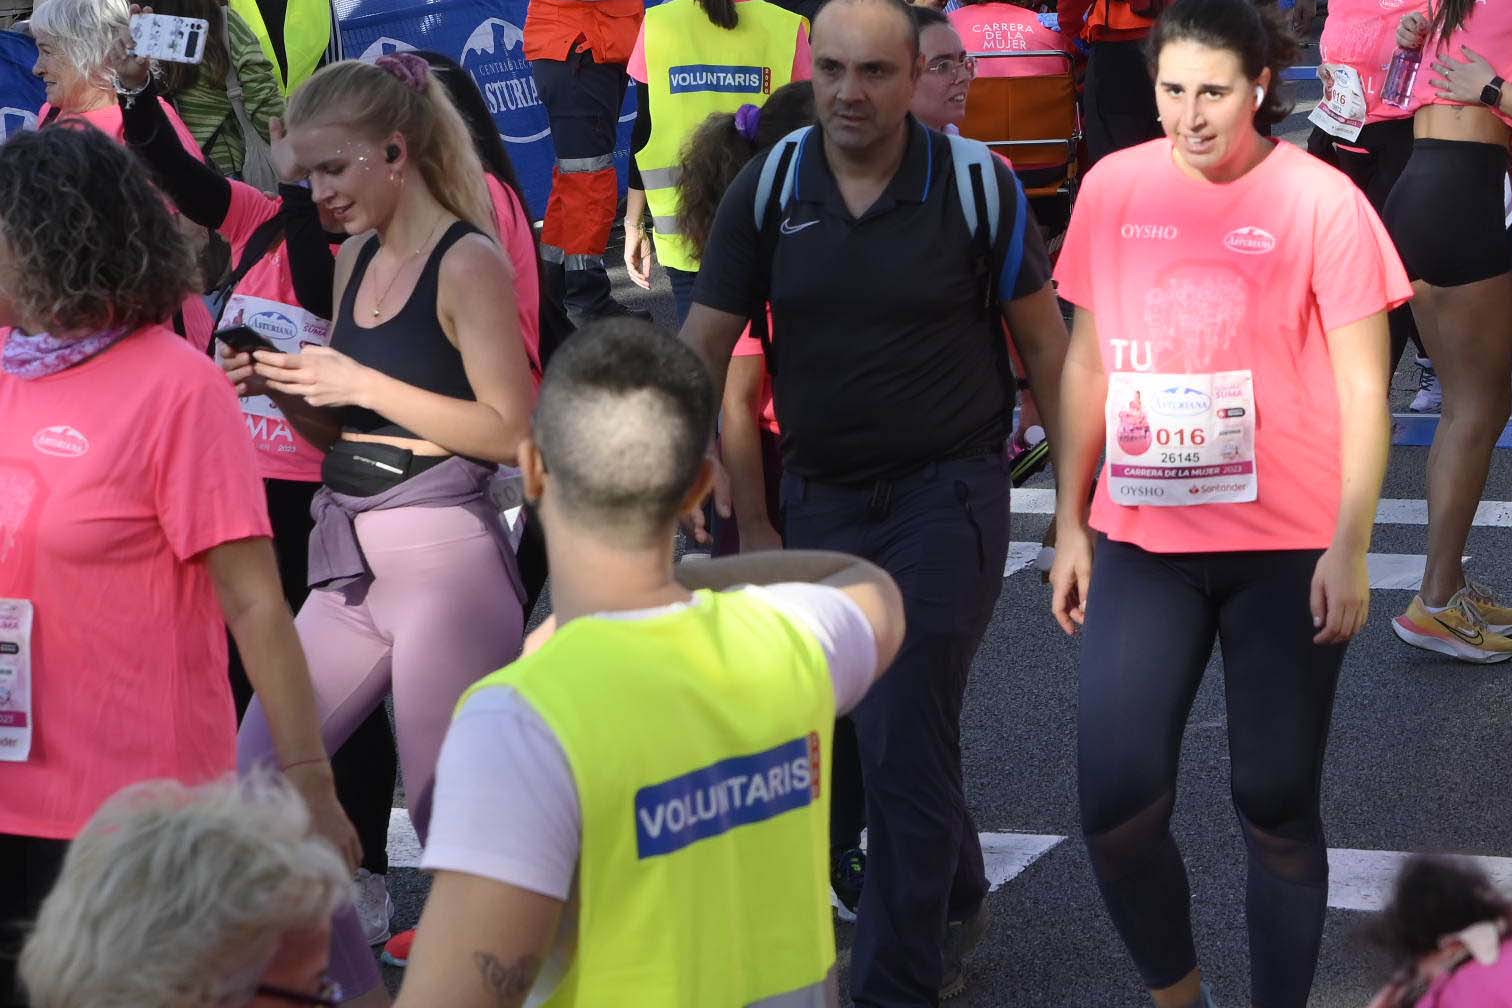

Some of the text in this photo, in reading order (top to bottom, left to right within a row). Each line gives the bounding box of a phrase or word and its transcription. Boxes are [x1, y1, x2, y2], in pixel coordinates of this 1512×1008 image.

[972, 21, 1034, 34] CARRERA
[985, 31, 1024, 40] DE LA
[983, 39, 1027, 49] MUJER
[670, 72, 760, 87] VOLUNTARIS
[485, 75, 544, 114] STURIA
[1120, 223, 1179, 240] OYSHO
[253, 318, 293, 337] ASTURIANA
[303, 324, 328, 337] SUMA
[1110, 338, 1151, 371] TU
[246, 414, 294, 442] MA
[1155, 428, 1206, 447] 016
[1161, 452, 1200, 464] 26145
[1124, 467, 1163, 477] CARRERA
[1164, 469, 1177, 478] DE
[1178, 469, 1189, 477] LA
[1191, 468, 1221, 477] MUJER
[1120, 482, 1247, 498] OYSHO Santander
